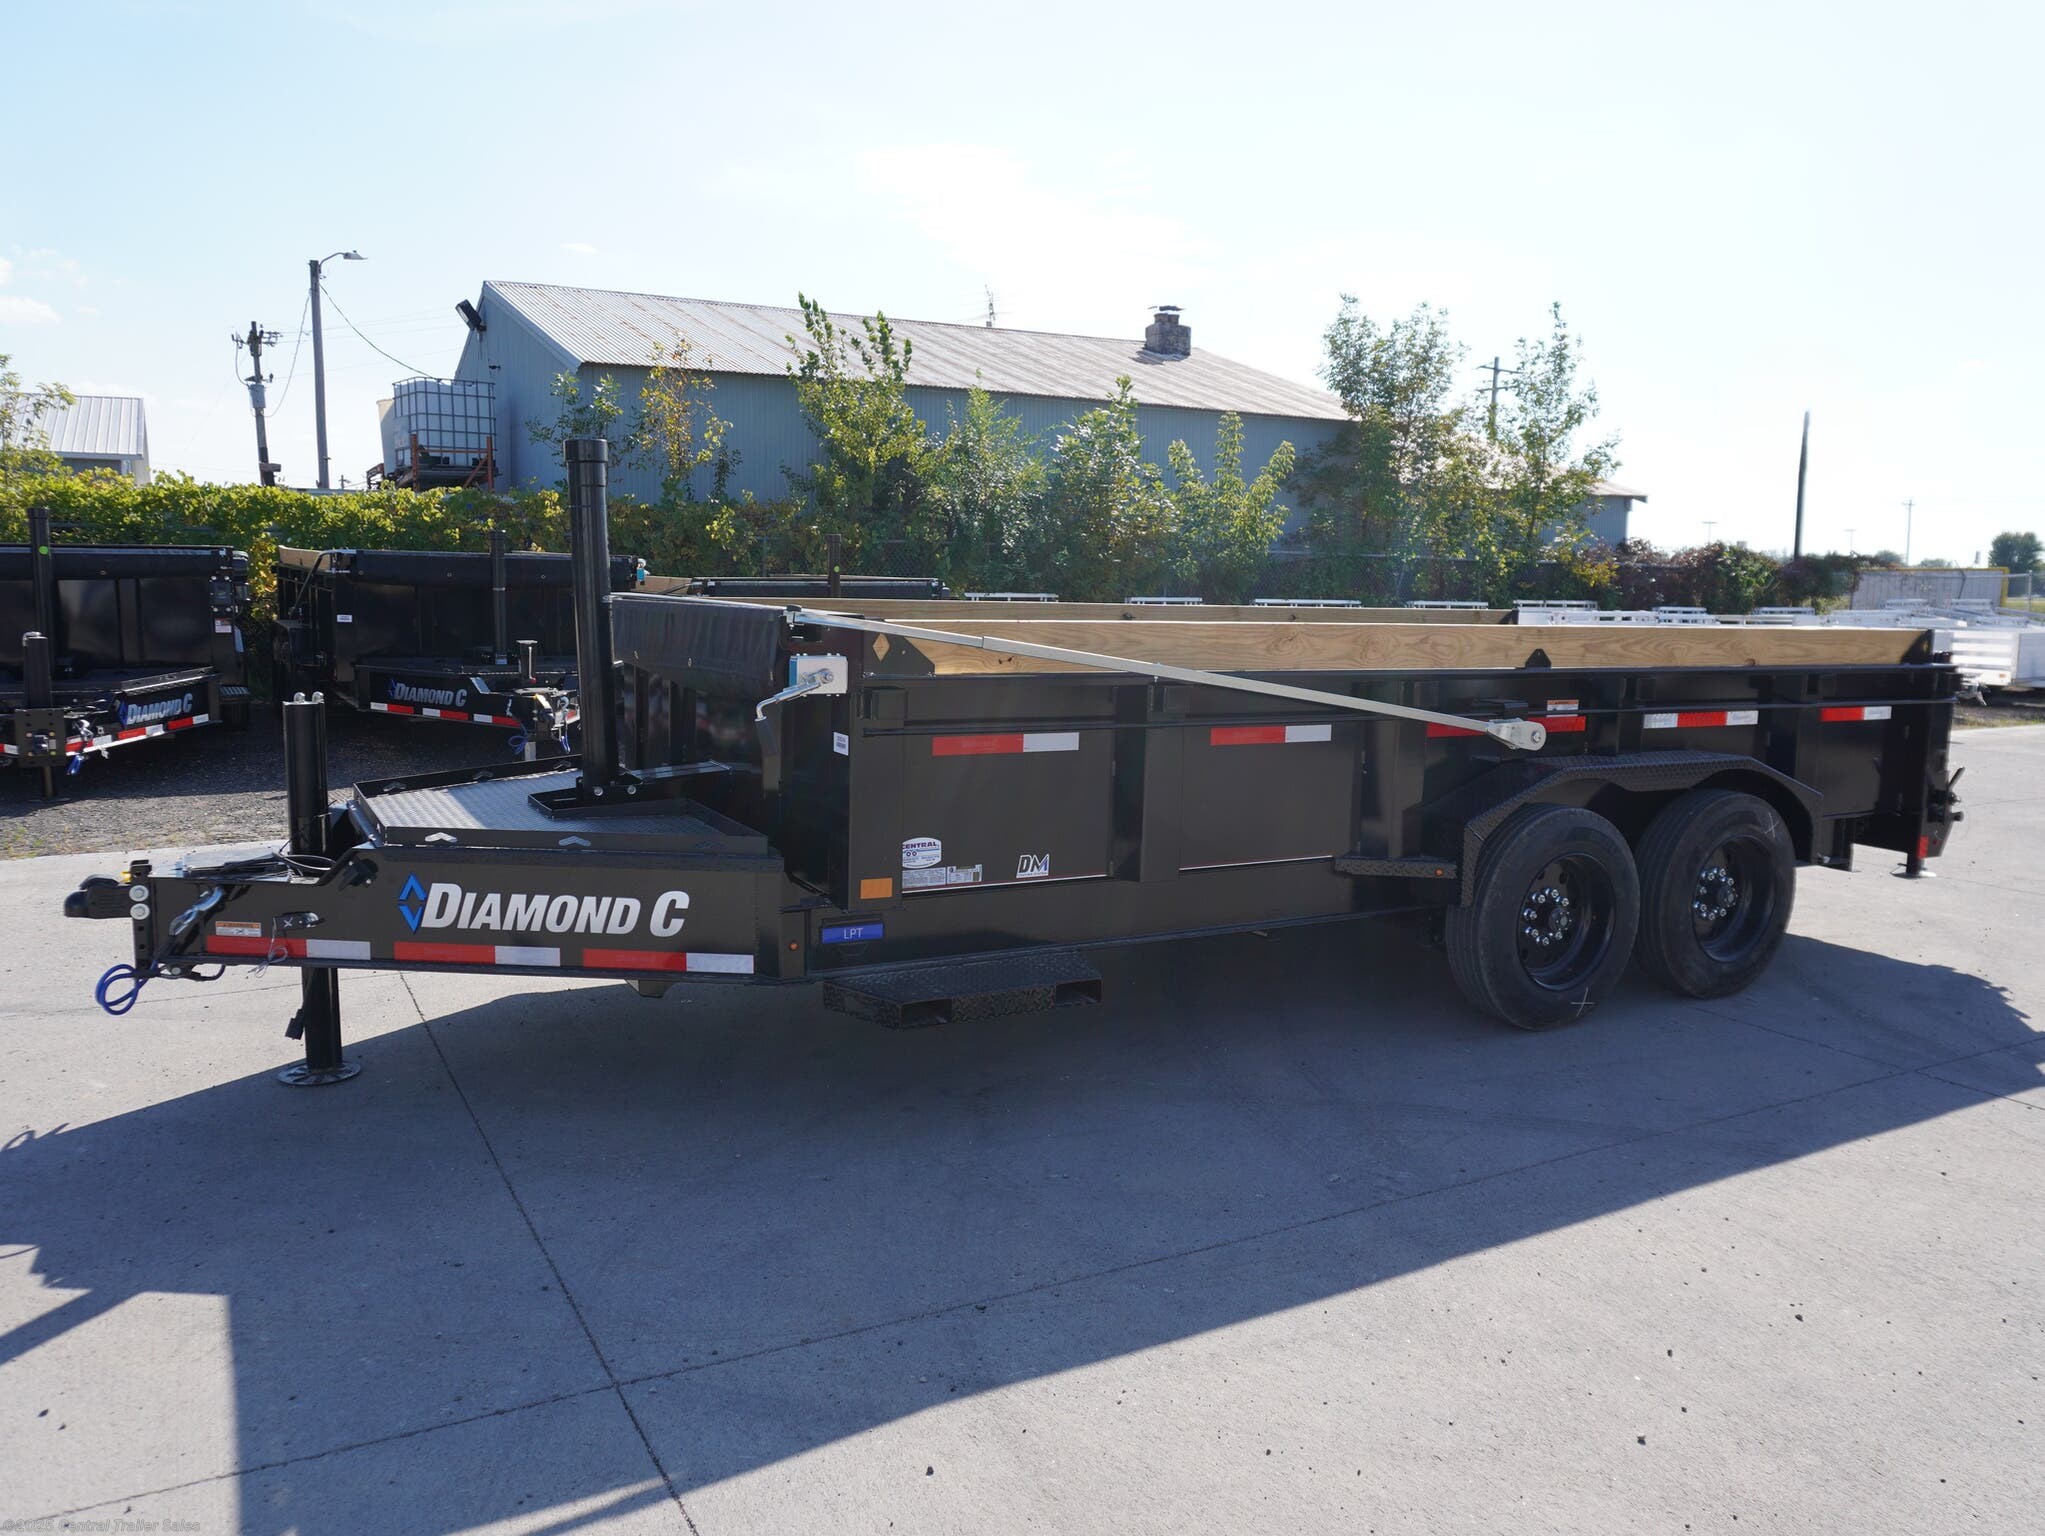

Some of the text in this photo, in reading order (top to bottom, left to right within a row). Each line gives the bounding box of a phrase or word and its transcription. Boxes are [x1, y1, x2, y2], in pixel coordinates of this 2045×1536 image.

[394, 682, 467, 707] DIAMOND C
[126, 693, 193, 725] DIAMOND C
[902, 841, 937, 850] CENTRAL
[1018, 854, 1050, 874] DM
[421, 883, 690, 937] DIAMOND C
[843, 927, 864, 940] LPT
